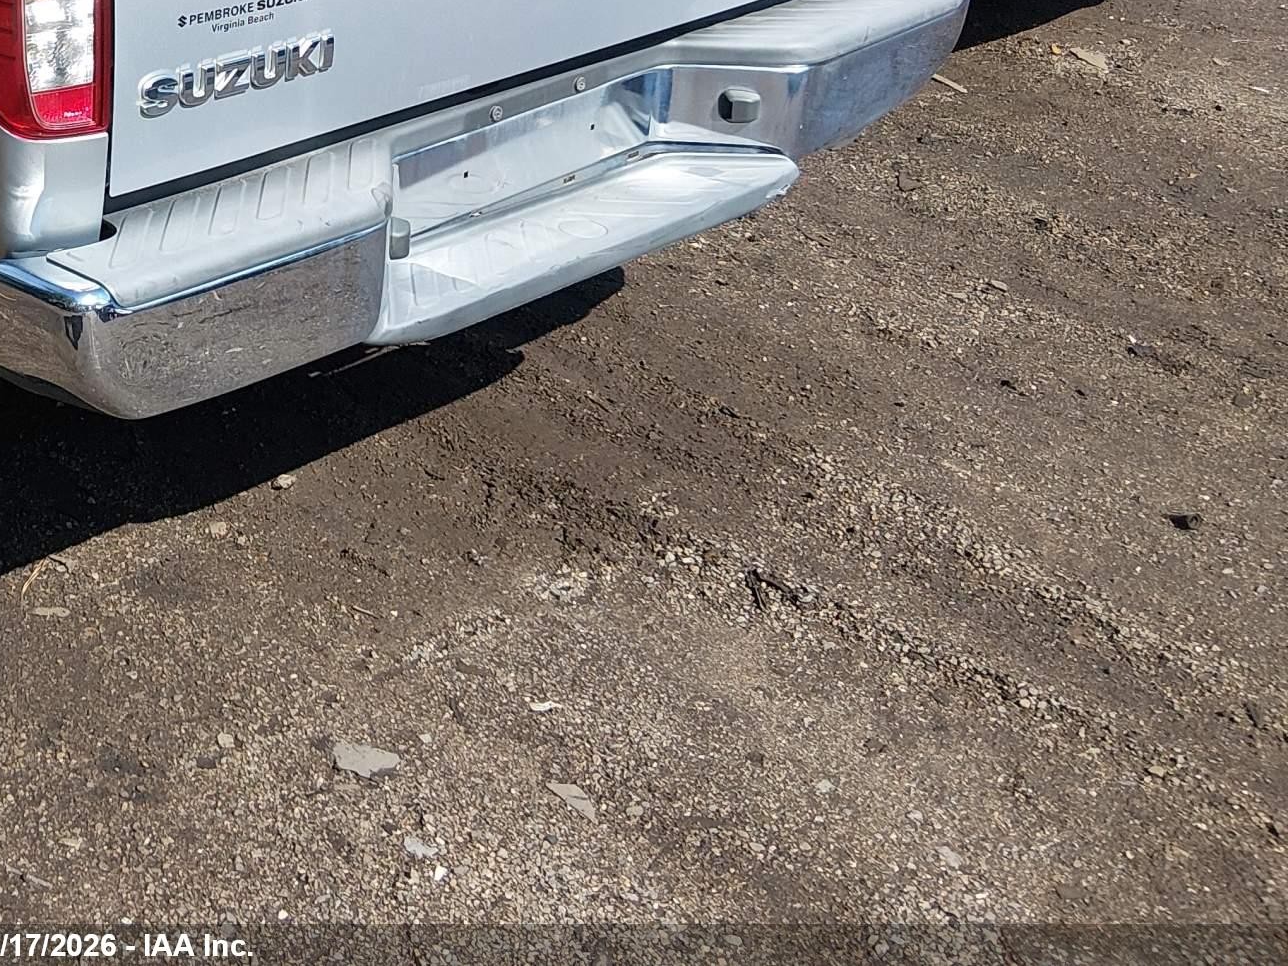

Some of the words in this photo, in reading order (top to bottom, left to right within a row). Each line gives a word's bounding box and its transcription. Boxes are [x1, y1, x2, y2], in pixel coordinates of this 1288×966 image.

[189, 1, 255, 26] PEMBROKE
[211, 19, 246, 33] Virginia
[247, 11, 275, 25] Beach
[136, 28, 336, 119] SUZUKI
